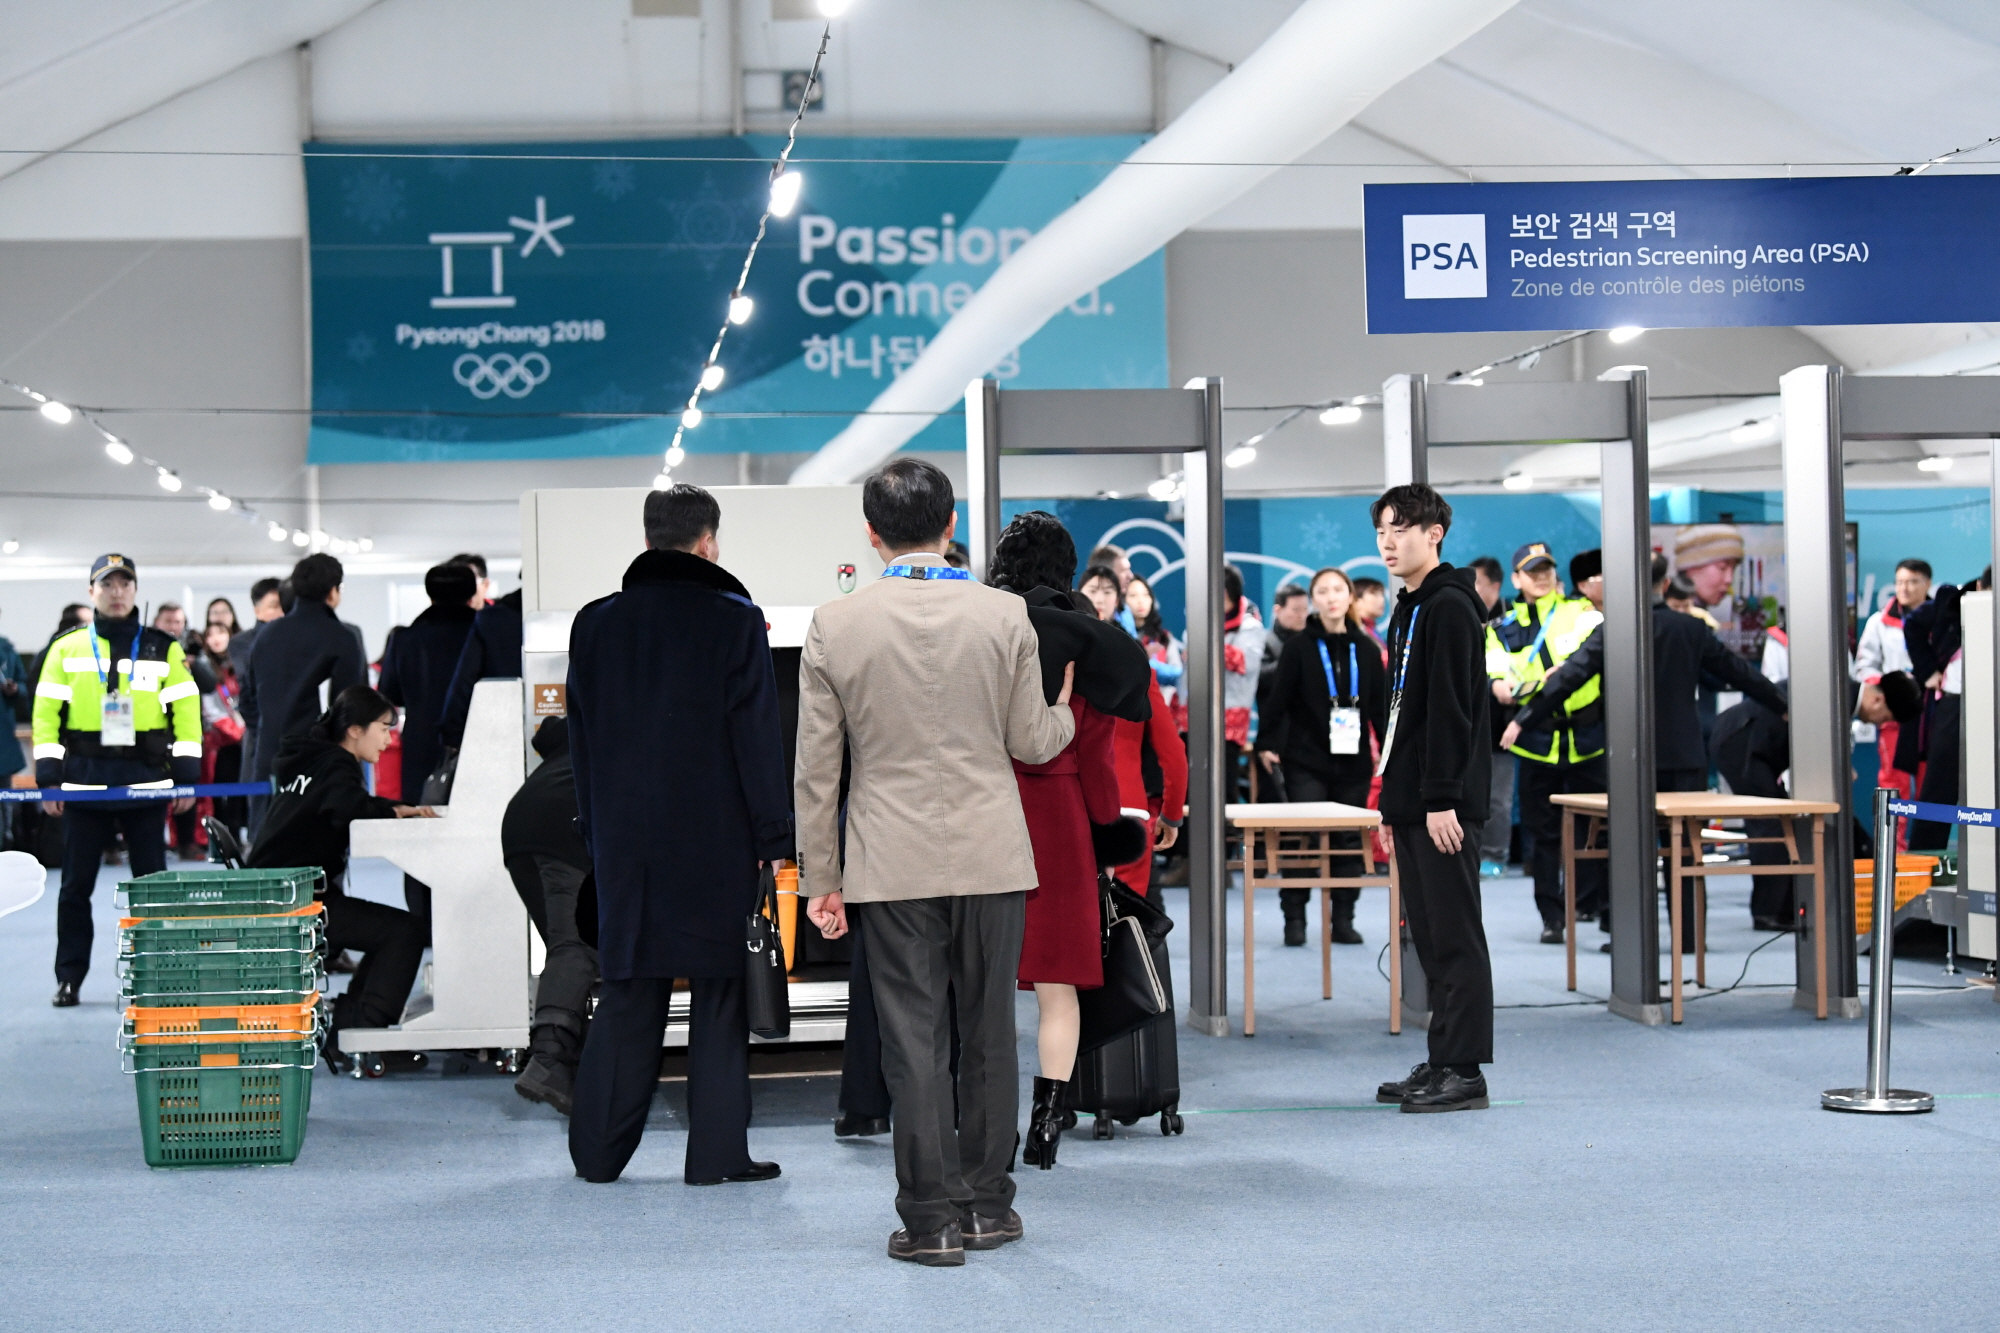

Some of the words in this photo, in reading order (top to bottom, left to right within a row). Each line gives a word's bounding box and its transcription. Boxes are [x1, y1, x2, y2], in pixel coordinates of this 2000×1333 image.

[1510, 213, 1560, 240] 보안
[1569, 212, 1618, 240] 검색
[1627, 210, 1676, 238] 구역
[1411, 242, 1479, 270] PSA
[1510, 247, 1632, 268] Pedestrian
[1637, 244, 1747, 270] Screening
[1751, 244, 1804, 264] Area
[1809, 241, 1870, 264] (PSA)
[1511, 278, 1563, 297] Zone
[1570, 277, 1595, 296] de
[1602, 275, 1682, 295] contrôle
[1689, 275, 1725, 294] des
[1732, 274, 1805, 297] piétons
[395, 322, 550, 349] PyeongChang
[552, 319, 606, 342] 2018
[1957, 810, 1983, 824] PyeongChang
